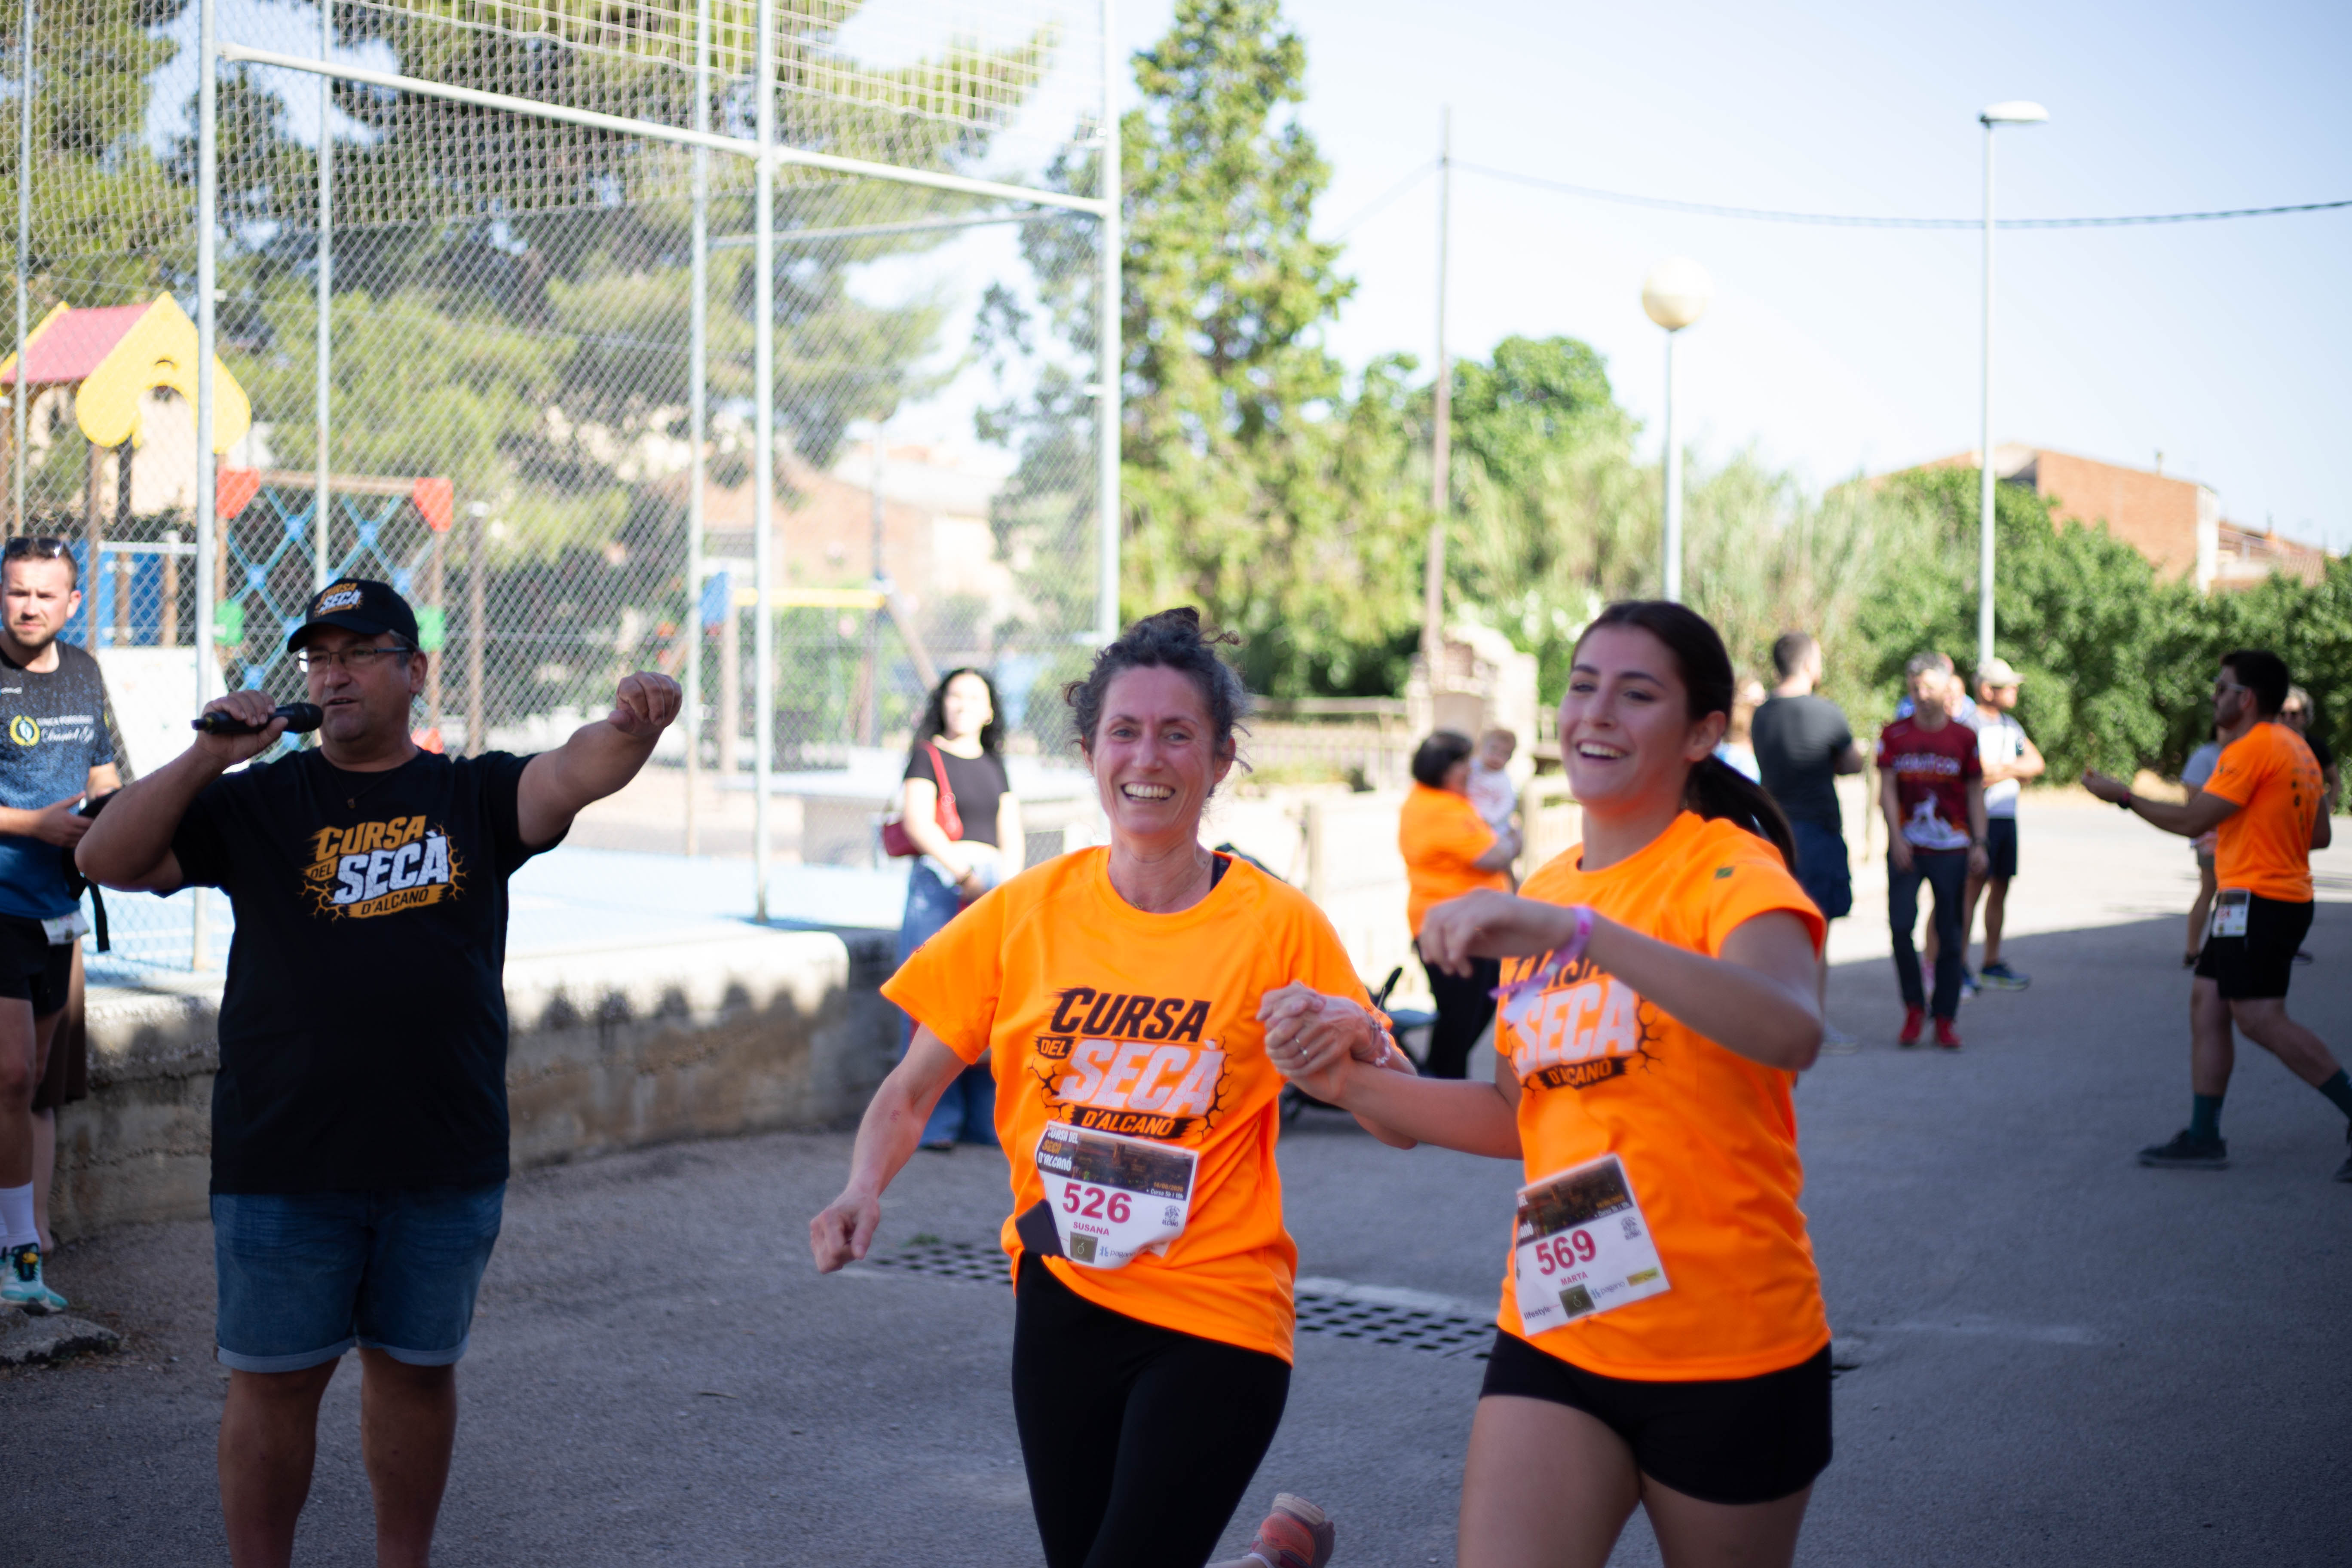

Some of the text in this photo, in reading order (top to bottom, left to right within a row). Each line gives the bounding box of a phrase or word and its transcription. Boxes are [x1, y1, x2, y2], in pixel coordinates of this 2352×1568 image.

[313, 815, 427, 862] CURSA
[310, 861, 332, 878] DEL
[329, 830, 449, 904] SECÀ
[1048, 987, 1212, 1042] CURSA
[1041, 1039, 1066, 1057] DEL
[1053, 1039, 1225, 1116] SECÀ
[1069, 1131, 1078, 1144] DEL
[1062, 1182, 1132, 1224] 526
[1073, 1222, 1109, 1236] SUSANA
[1535, 1229, 1596, 1276] 569
[1561, 1271, 1588, 1286] MARTA
